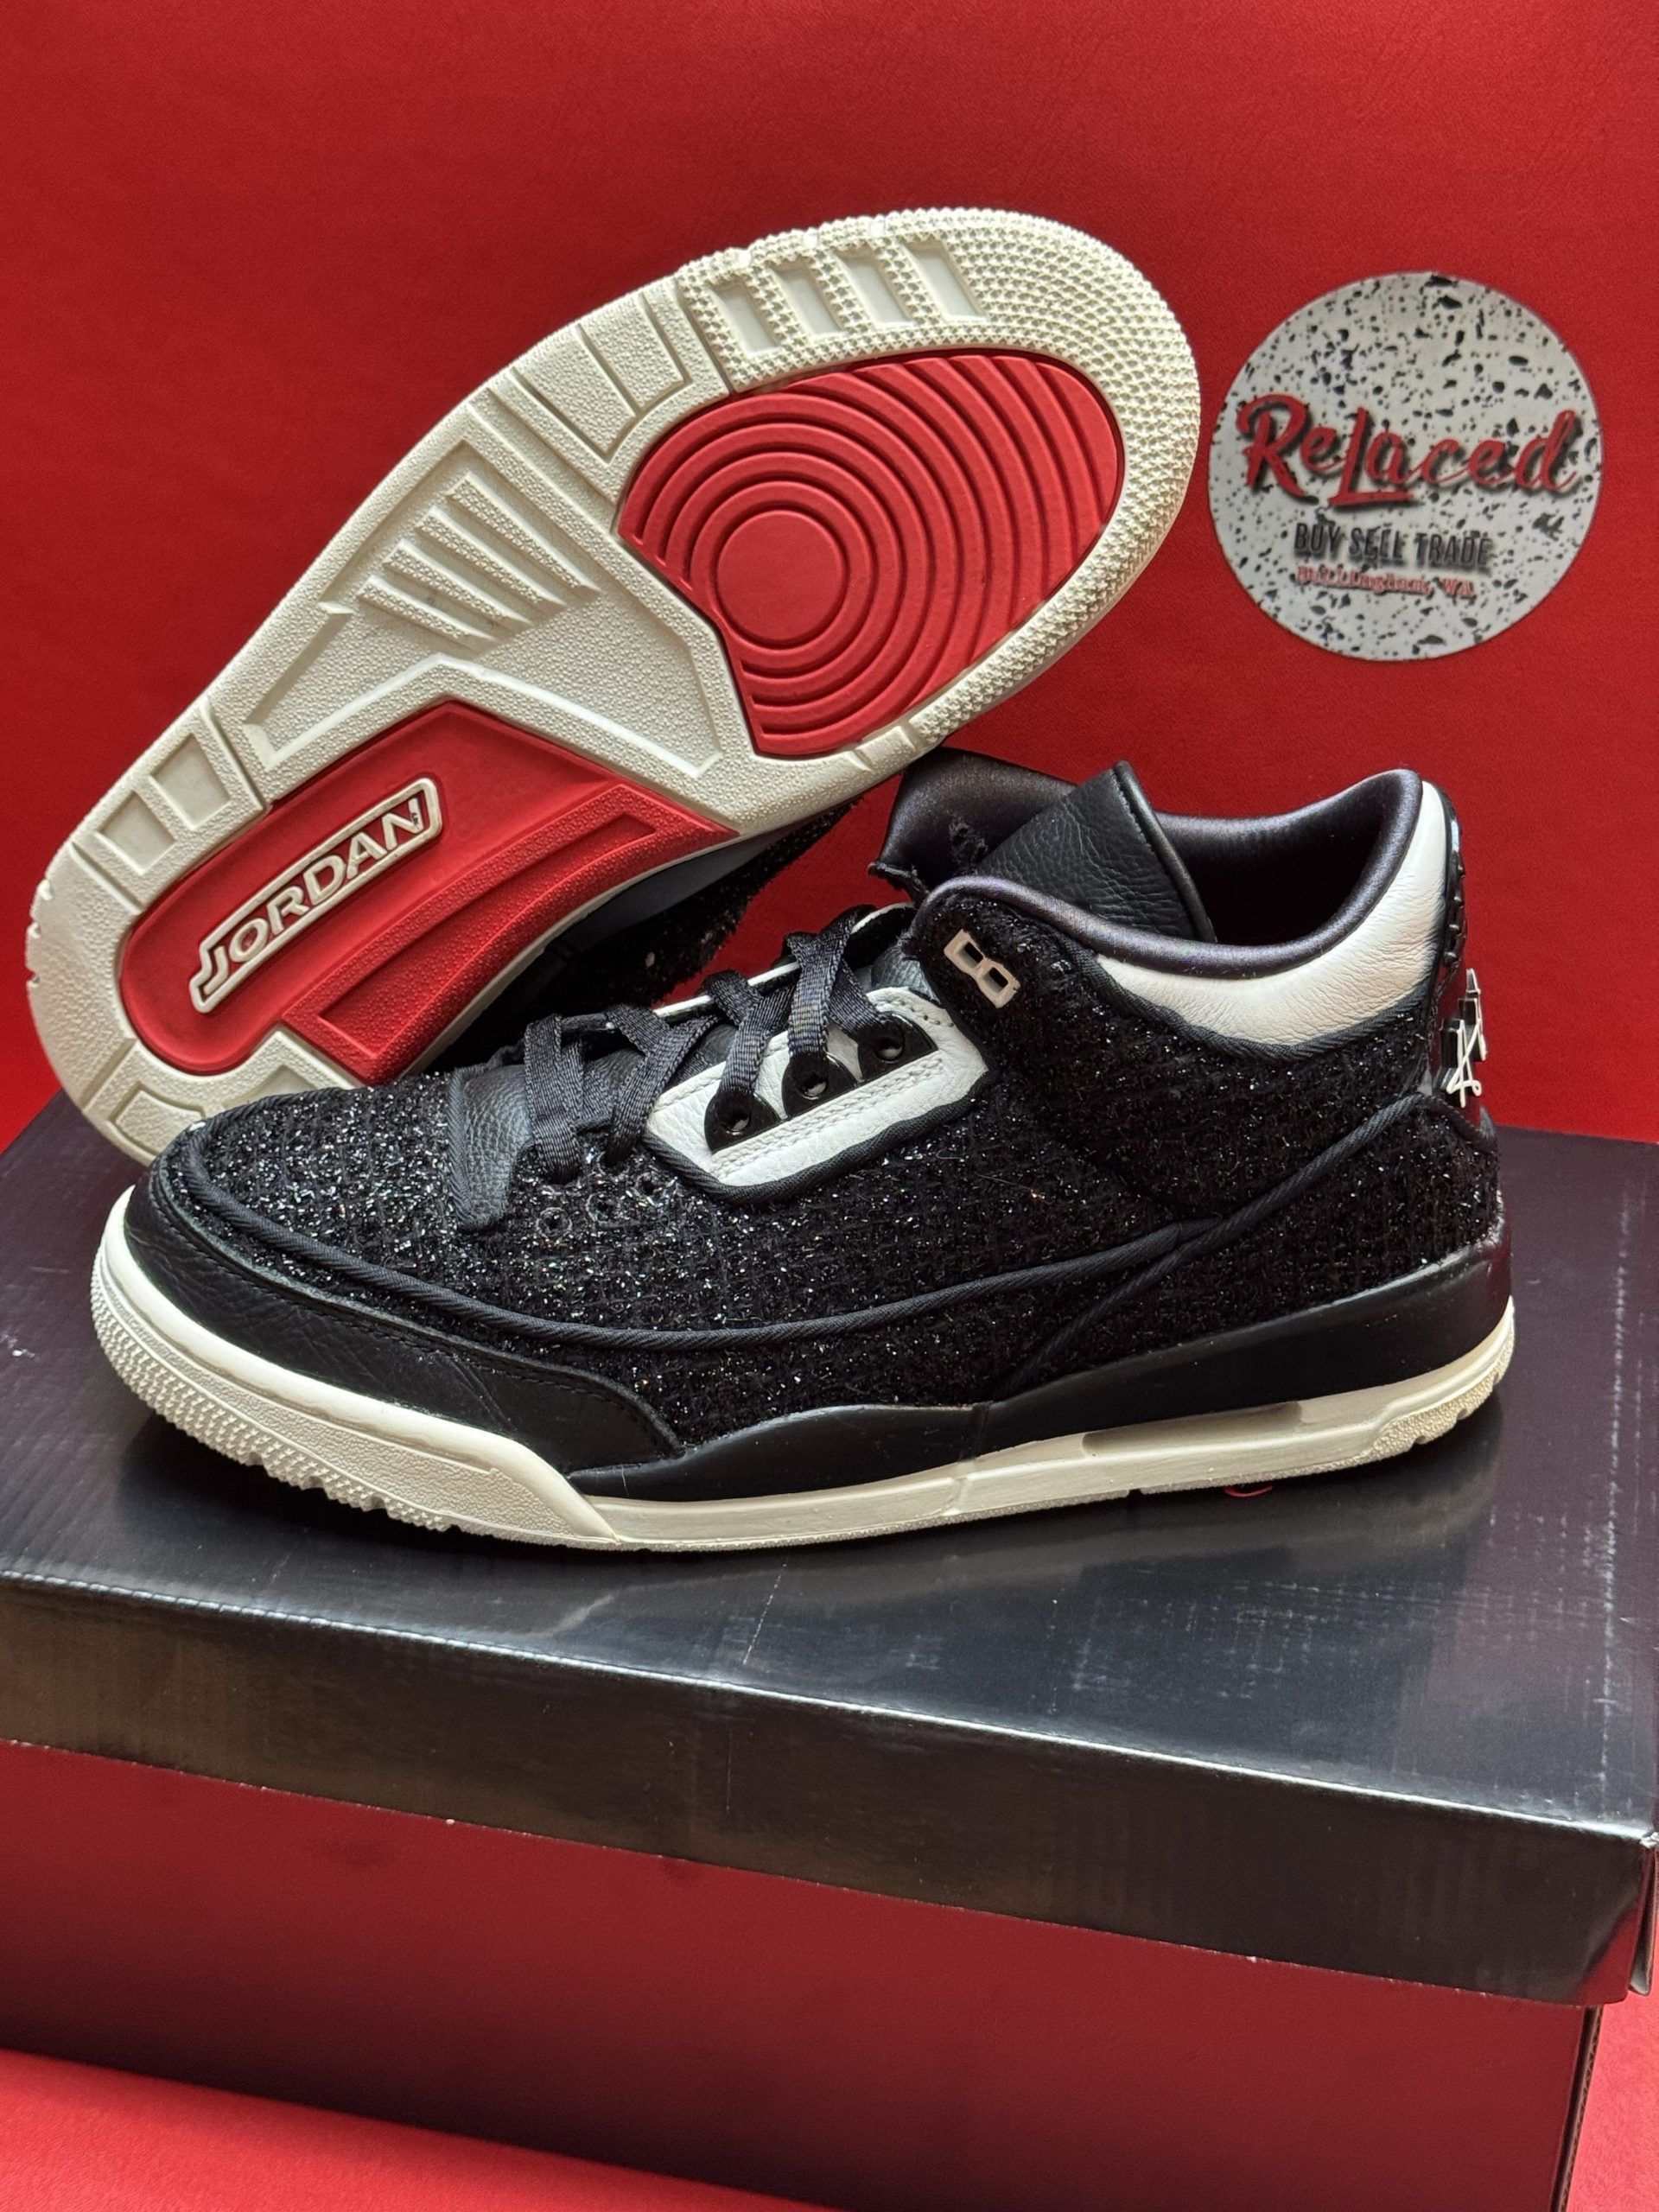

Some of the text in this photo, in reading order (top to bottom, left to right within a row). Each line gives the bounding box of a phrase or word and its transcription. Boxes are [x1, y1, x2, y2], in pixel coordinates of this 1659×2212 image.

[1236, 393, 1578, 506] ReLaced
[1294, 522, 1493, 568] BUY SELL TRADE
[203, 797, 425, 995] JORDAN
